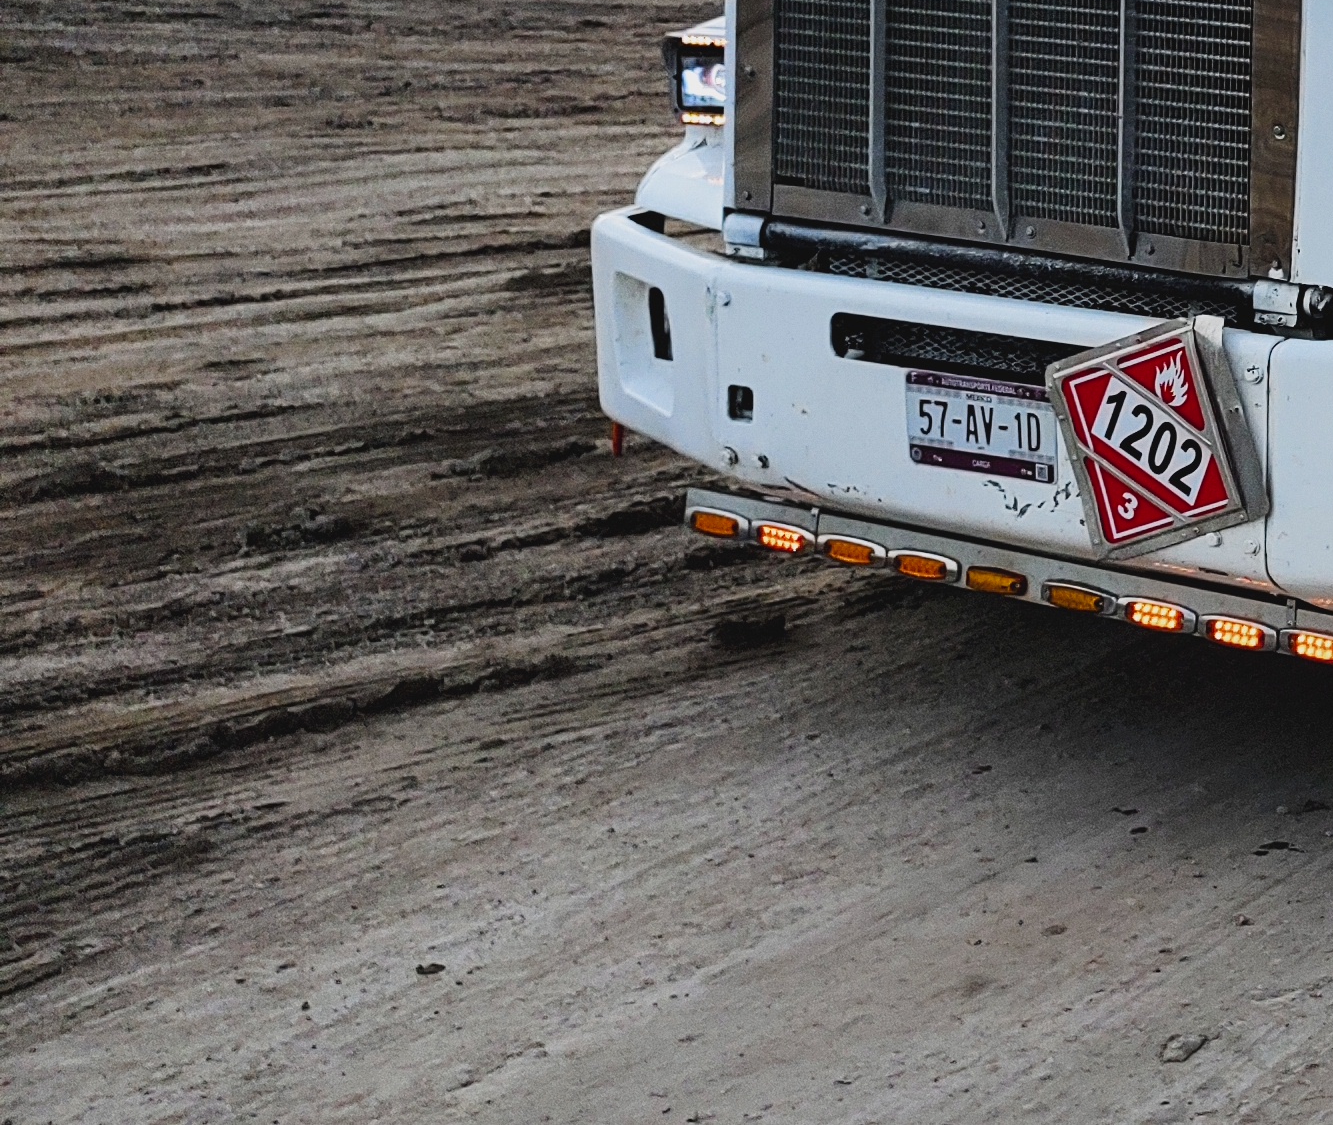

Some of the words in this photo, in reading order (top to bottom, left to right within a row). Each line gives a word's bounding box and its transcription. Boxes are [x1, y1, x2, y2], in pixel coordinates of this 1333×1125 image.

[918, 399, 1041, 452] 57-AV-1D
[1105, 390, 1203, 496] 1202
[1117, 492, 1138, 520] 3
